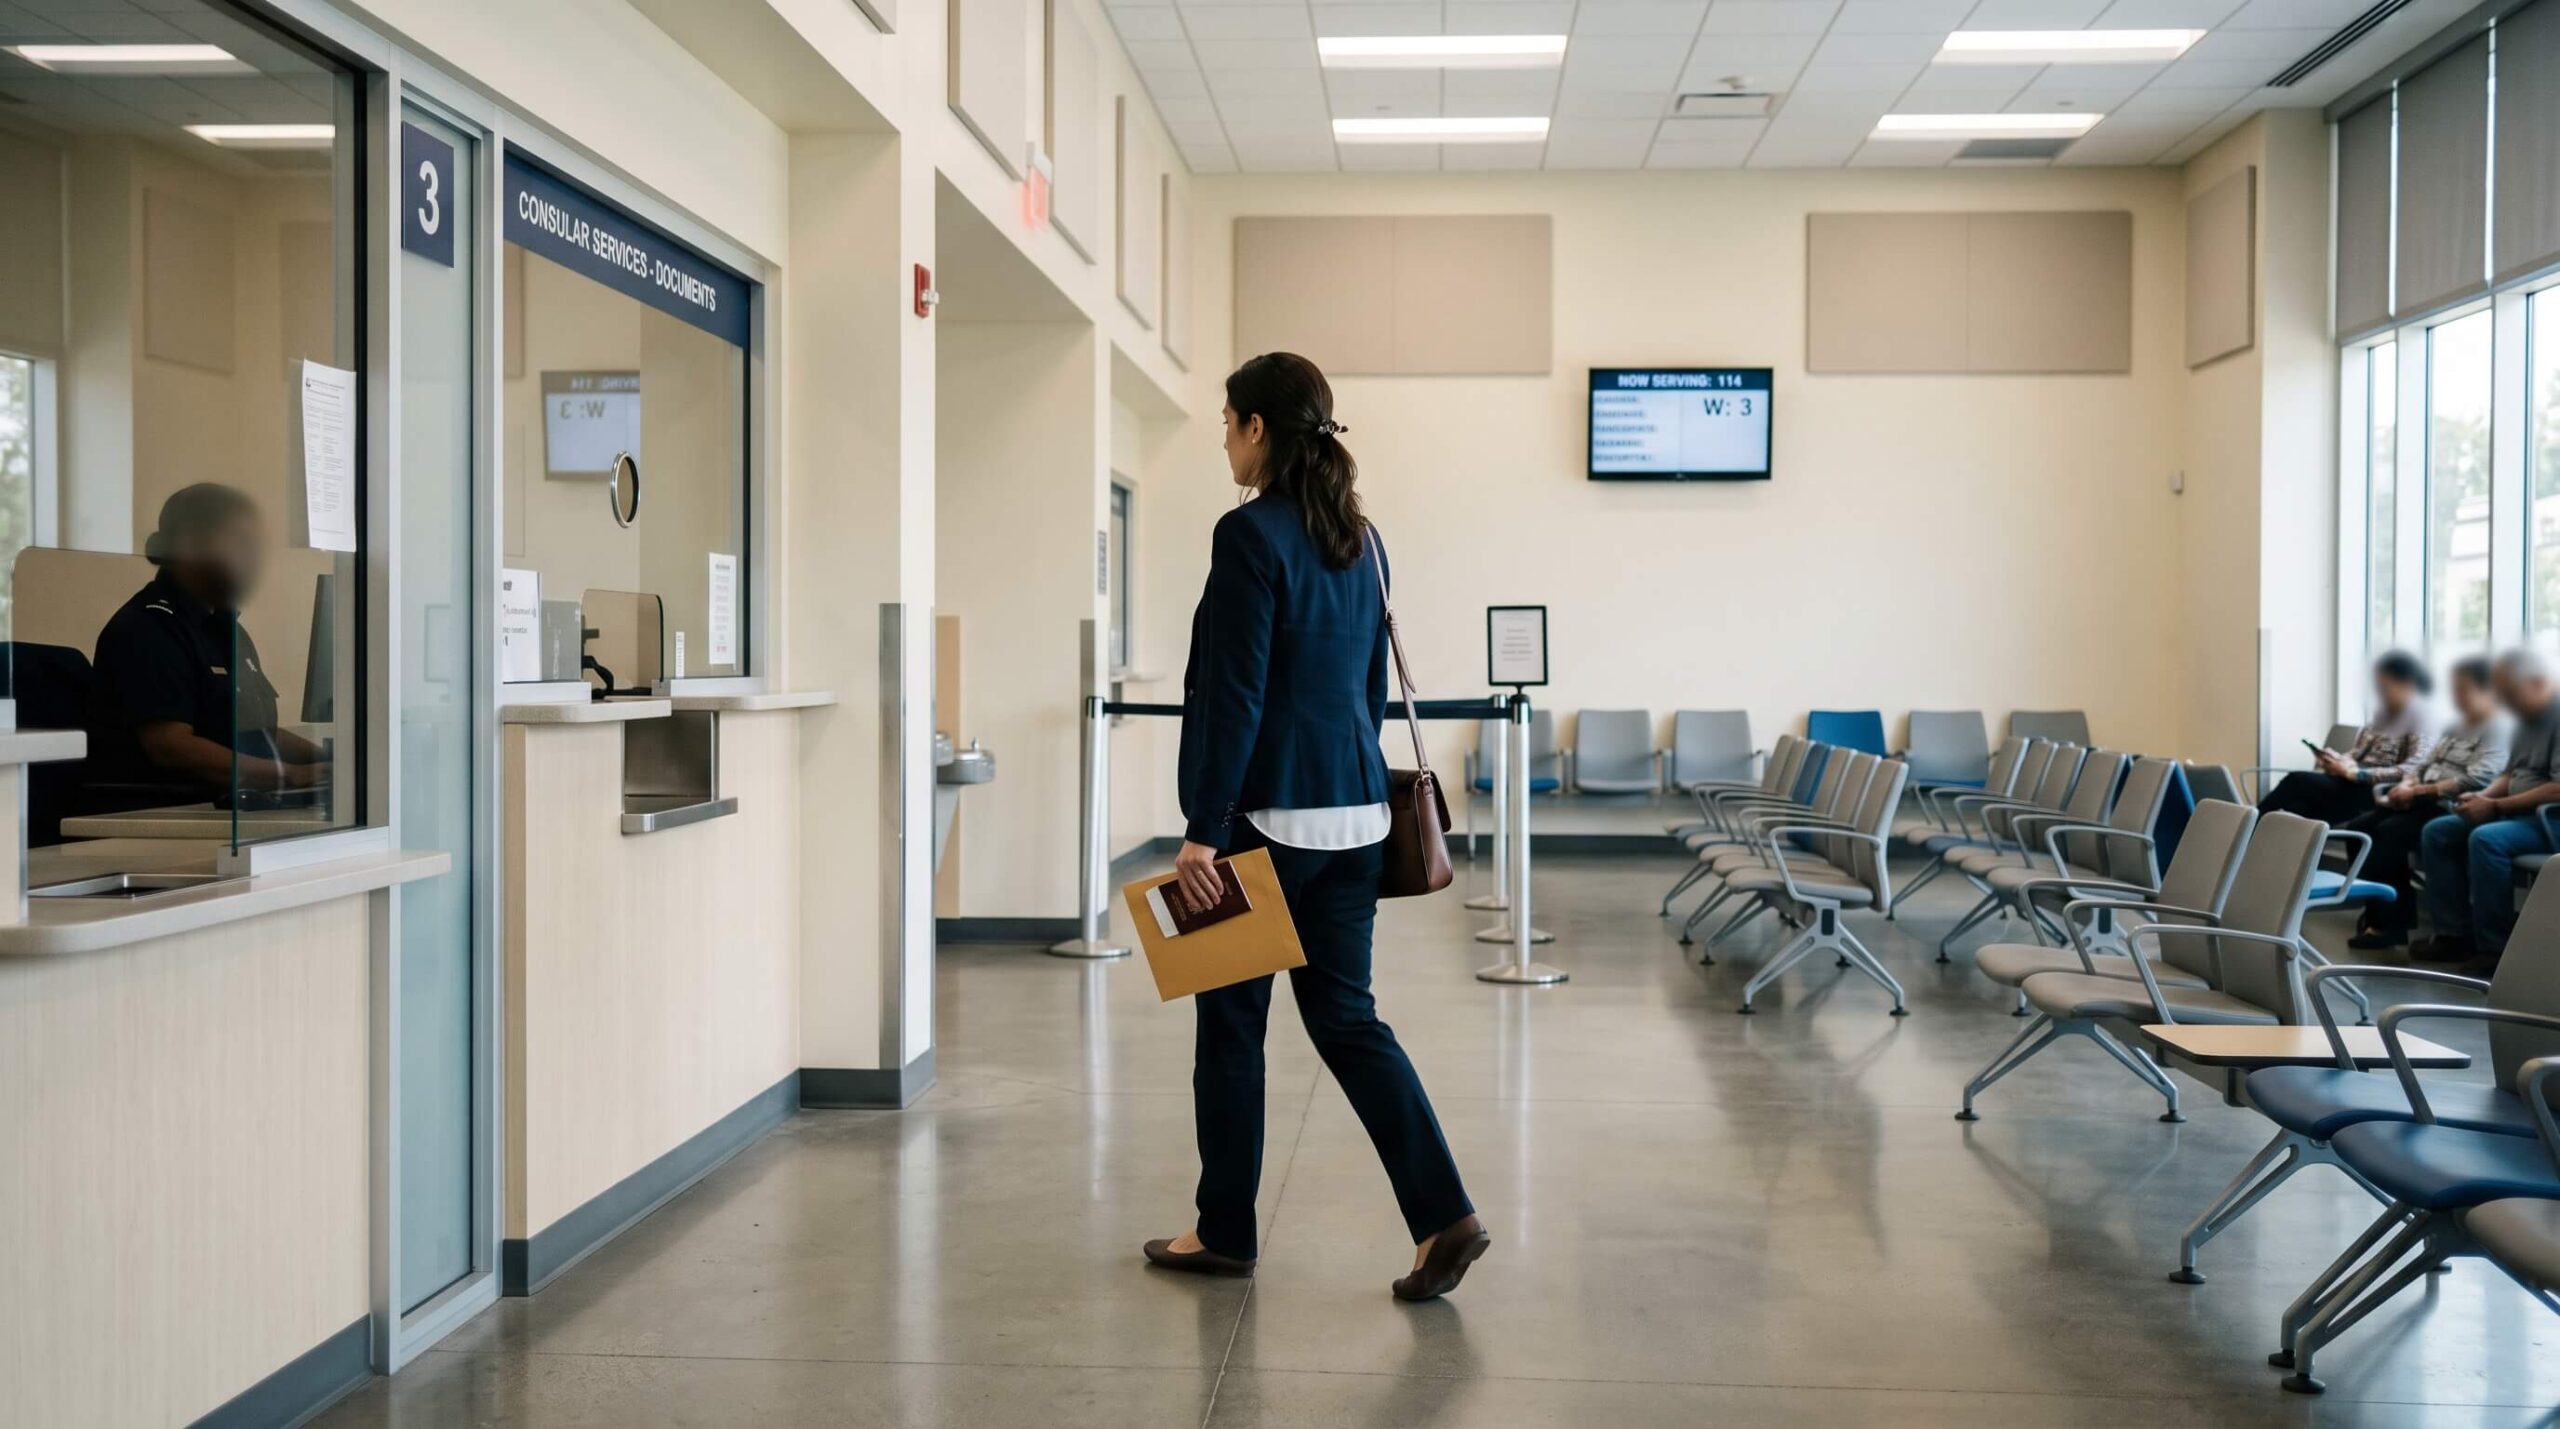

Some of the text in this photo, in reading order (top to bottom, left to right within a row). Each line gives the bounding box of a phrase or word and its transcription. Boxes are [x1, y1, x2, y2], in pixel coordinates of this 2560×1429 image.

[418, 160, 440, 235] 3
[519, 190, 590, 251] CONSULAR
[592, 227, 647, 280] SERVICES
[655, 260, 716, 312] DOCUMENTS
[1618, 374, 1742, 387] NOW SERVING: 114
[1703, 398, 1752, 416] W: 3
